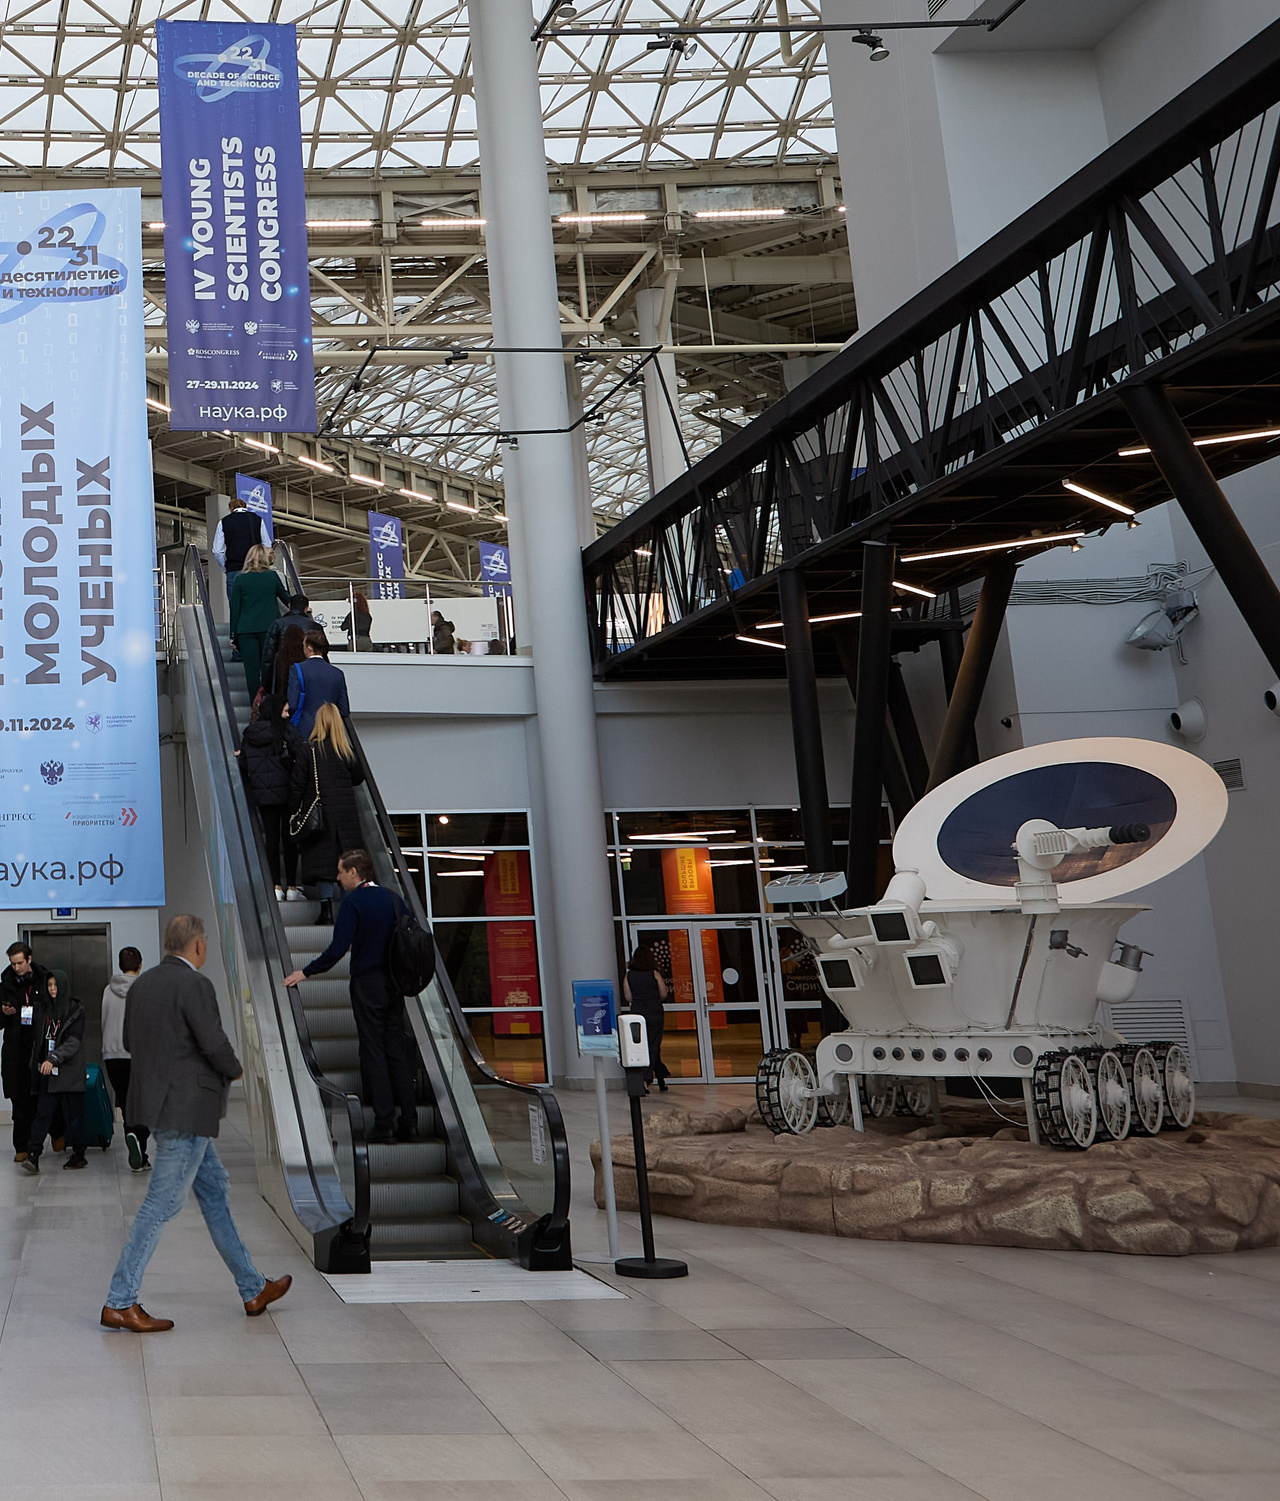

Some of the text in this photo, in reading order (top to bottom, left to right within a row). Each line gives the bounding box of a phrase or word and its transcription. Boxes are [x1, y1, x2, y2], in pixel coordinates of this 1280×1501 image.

[230, 46, 253, 60] 22
[250, 59, 267, 71] 31
[188, 71, 280, 81] DECADE OF SCIENCE
[196, 79, 280, 89] AND TECHNOLOGY
[221, 136, 250, 302] SCIENTISTS
[254, 146, 283, 302] CONGRESS
[38, 226, 76, 249] 22
[189, 158, 216, 300] IV YOUNG
[69, 246, 98, 266] 31
[0, 268, 120, 284] десятилетие
[2, 286, 14, 299] и
[17, 282, 120, 298] технологий
[200, 404, 288, 422] наука.рф
[20, 400, 63, 685] МОЛОДЫХ
[76, 456, 117, 686] УЧЕНЫХ
[786, 981, 821, 993] Сириу
